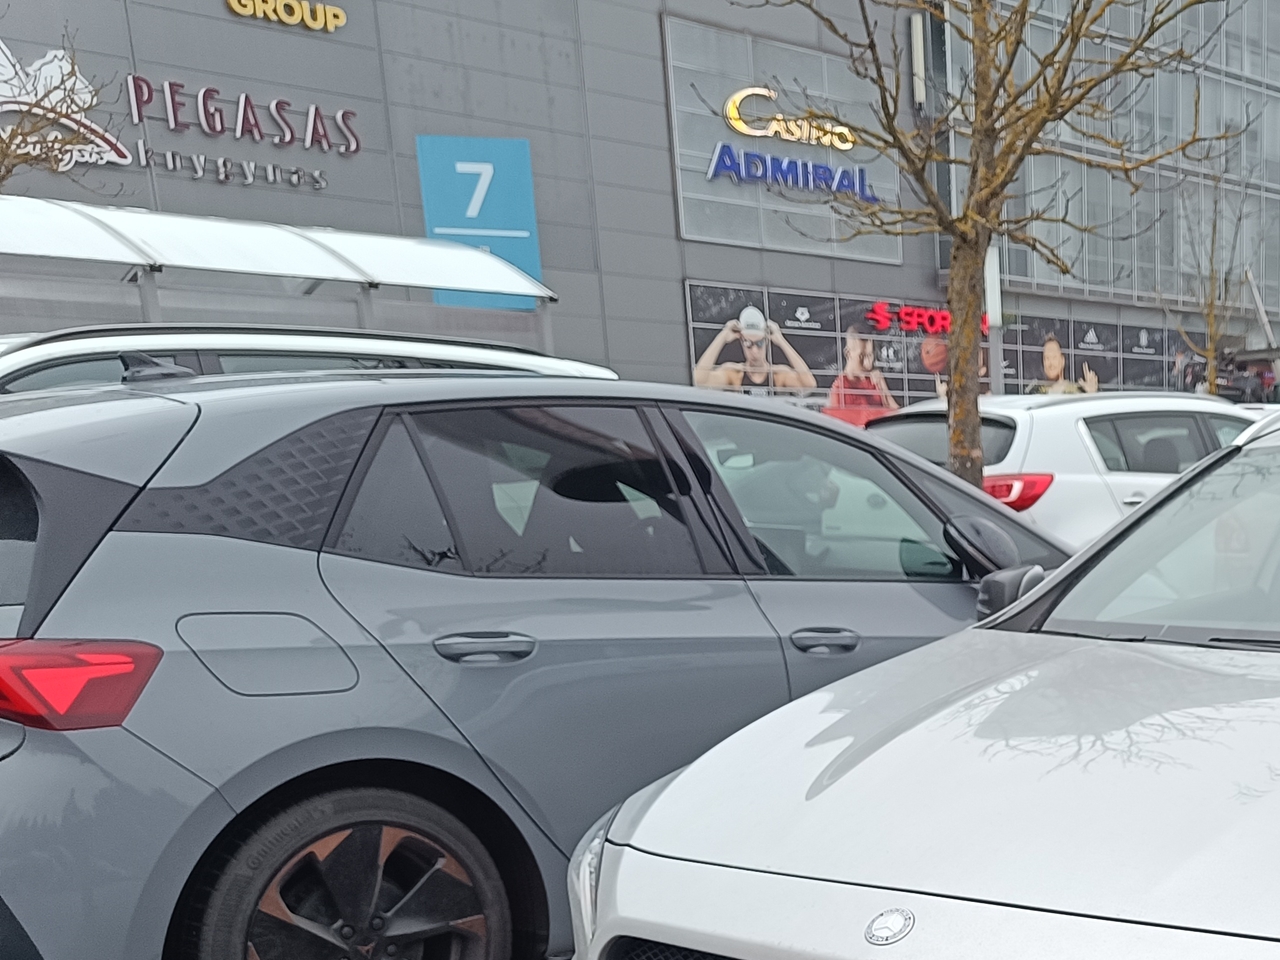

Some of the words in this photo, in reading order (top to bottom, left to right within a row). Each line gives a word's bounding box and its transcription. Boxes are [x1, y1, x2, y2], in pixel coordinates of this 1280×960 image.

[227, 0, 347, 33] GROUP
[127, 74, 361, 156] PEGASAS
[136, 138, 329, 190] knygynas
[455, 161, 495, 218] 7
[706, 140, 880, 204] ADMIRAL
